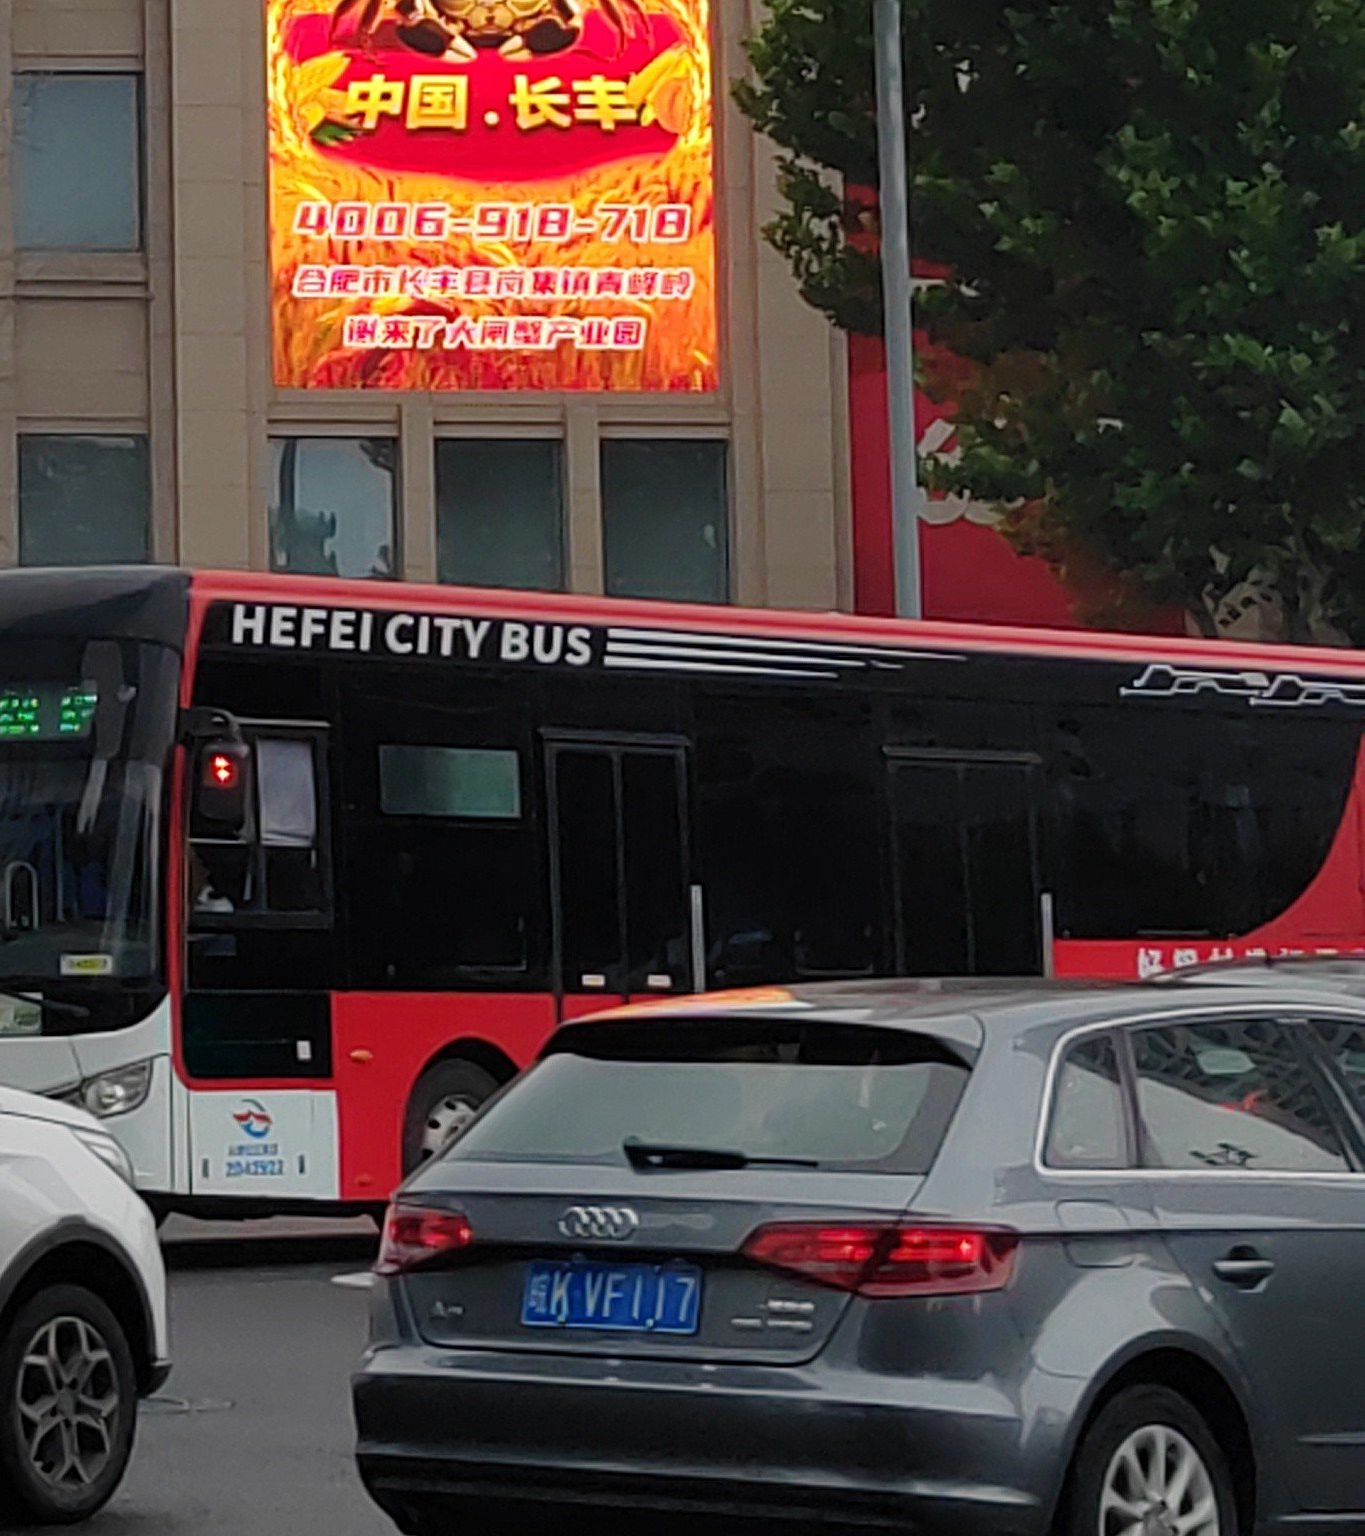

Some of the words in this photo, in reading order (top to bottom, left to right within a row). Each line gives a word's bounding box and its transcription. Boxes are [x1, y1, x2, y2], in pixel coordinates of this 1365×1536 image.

[295, 202, 691, 243] 4006-918-718
[232, 604, 372, 652] HEFEI
[385, 615, 491, 658] CITY
[500, 623, 592, 666] BUS
